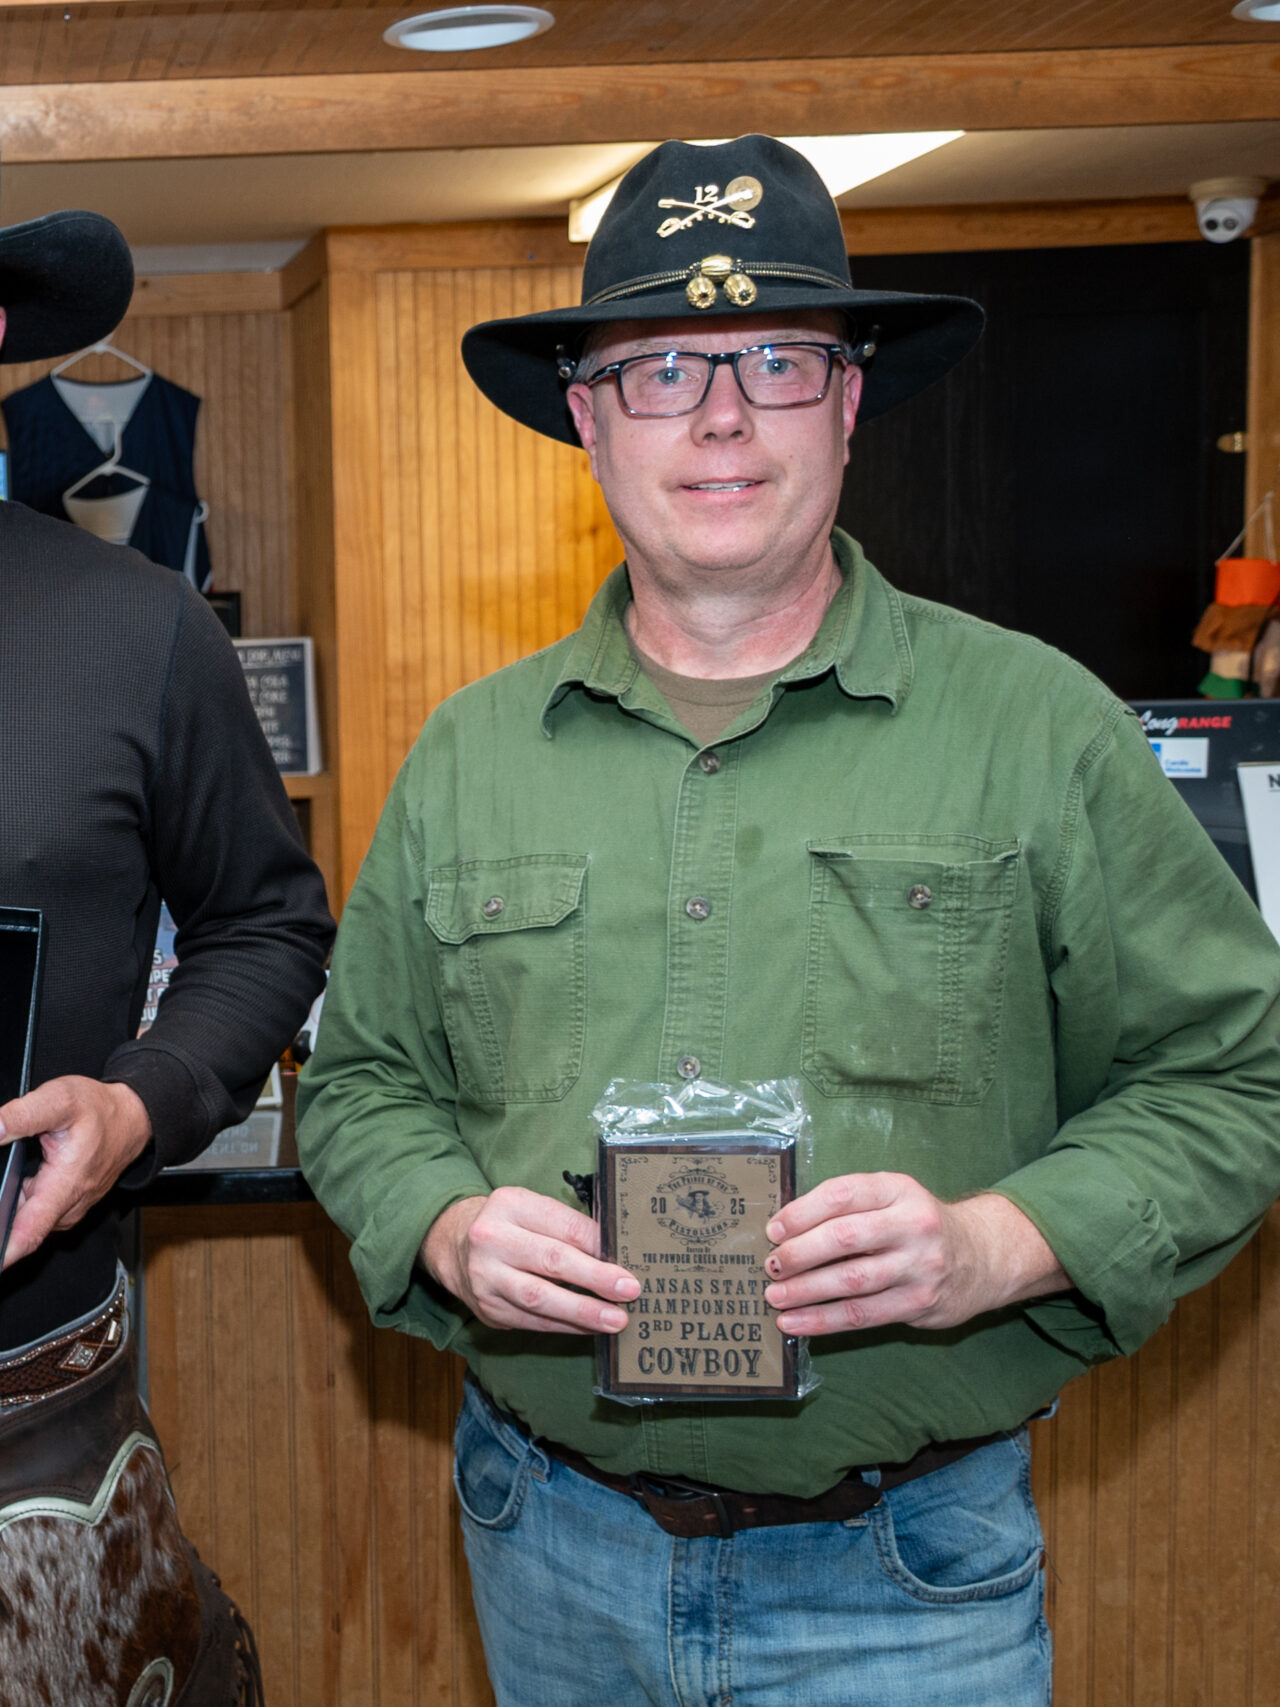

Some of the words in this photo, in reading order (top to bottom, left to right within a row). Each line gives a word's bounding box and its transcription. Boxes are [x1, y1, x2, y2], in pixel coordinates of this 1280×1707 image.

[694, 184, 719, 203] 12
[651, 1197, 666, 1214] 20
[730, 1198, 745, 1215] 25
[642, 1253, 657, 1263] THE
[659, 1253, 691, 1264] POWDER
[693, 1254, 717, 1264] CREEK
[720, 1254, 755, 1265] COWBOYS
[642, 1278, 703, 1295] ANSAS
[626, 1298, 771, 1316] CHAMPIONSHIP
[638, 1320, 673, 1340] 3RD
[680, 1322, 762, 1341] PLACE
[638, 1346, 763, 1378] COWBOY
